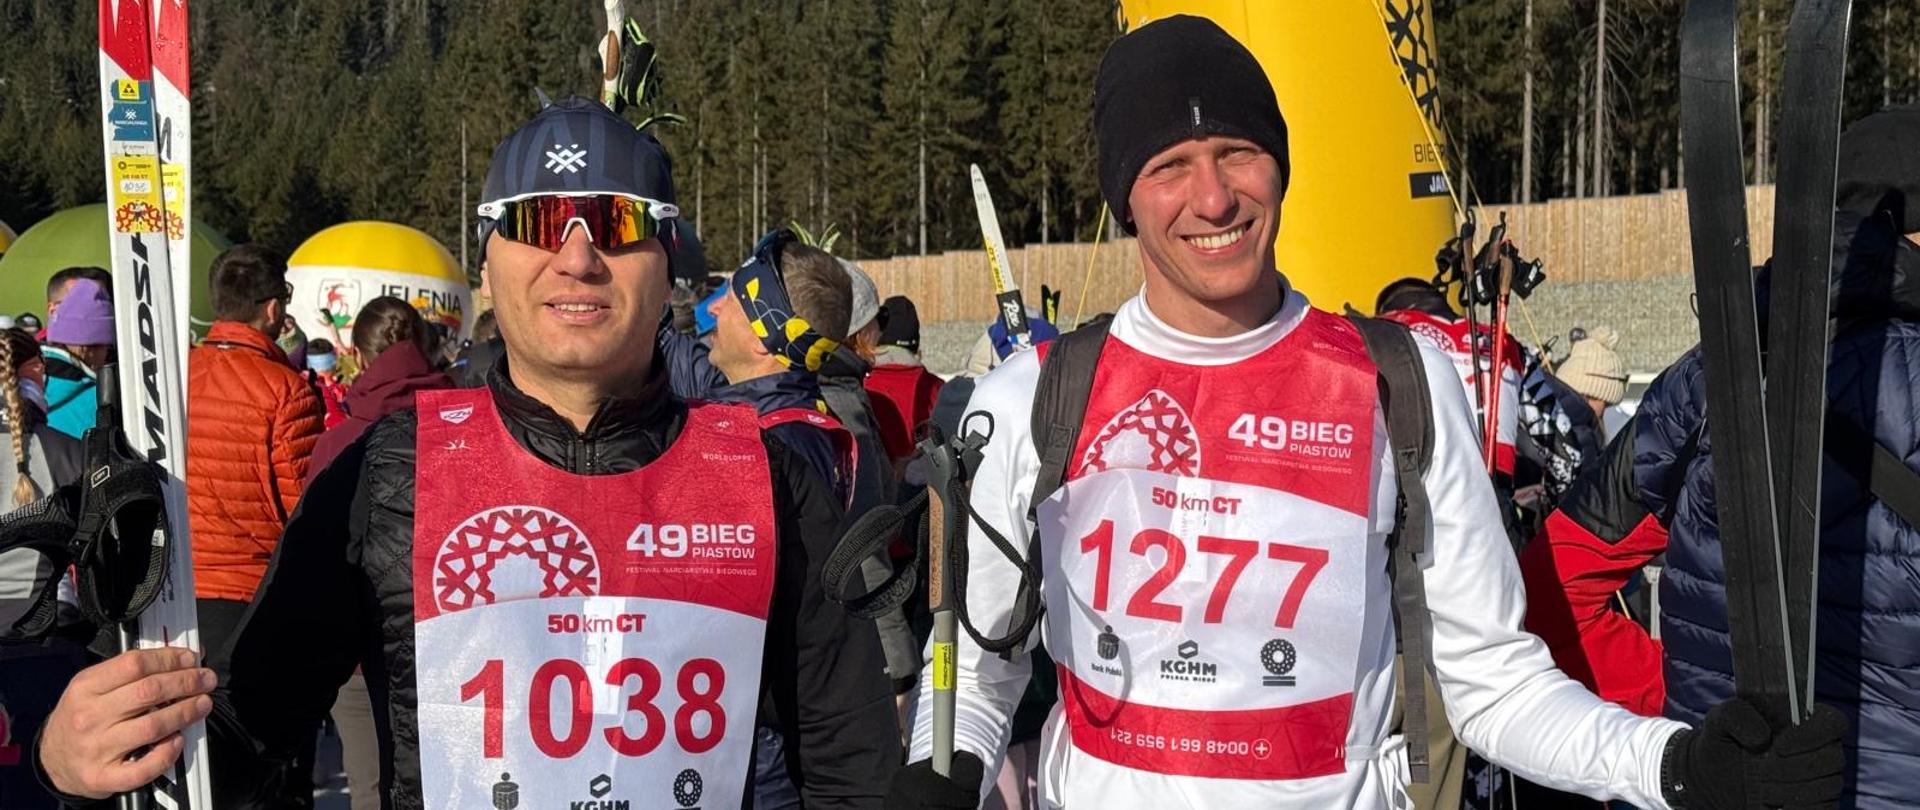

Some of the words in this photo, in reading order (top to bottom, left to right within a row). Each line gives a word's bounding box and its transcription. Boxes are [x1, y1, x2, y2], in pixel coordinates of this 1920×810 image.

[1228, 413, 1287, 450] 49
[1290, 420, 1354, 445] BIEG
[1152, 486, 1178, 509] 50
[1180, 492, 1210, 512] km
[1212, 496, 1242, 515] CT
[626, 523, 688, 558] 49
[691, 523, 755, 545] BIEG
[1080, 519, 1330, 630] 1277
[547, 613, 580, 634] 50
[582, 613, 613, 633] km
[616, 613, 647, 633] CT
[1160, 660, 1217, 676] KGHM
[460, 657, 727, 759] 1038
[1111, 727, 1132, 745] 221
[1136, 734, 1165, 750] 959
[1171, 737, 1201, 752] 661
[1206, 740, 1249, 755] 0048
[570, 800, 631, 810] KGHM
